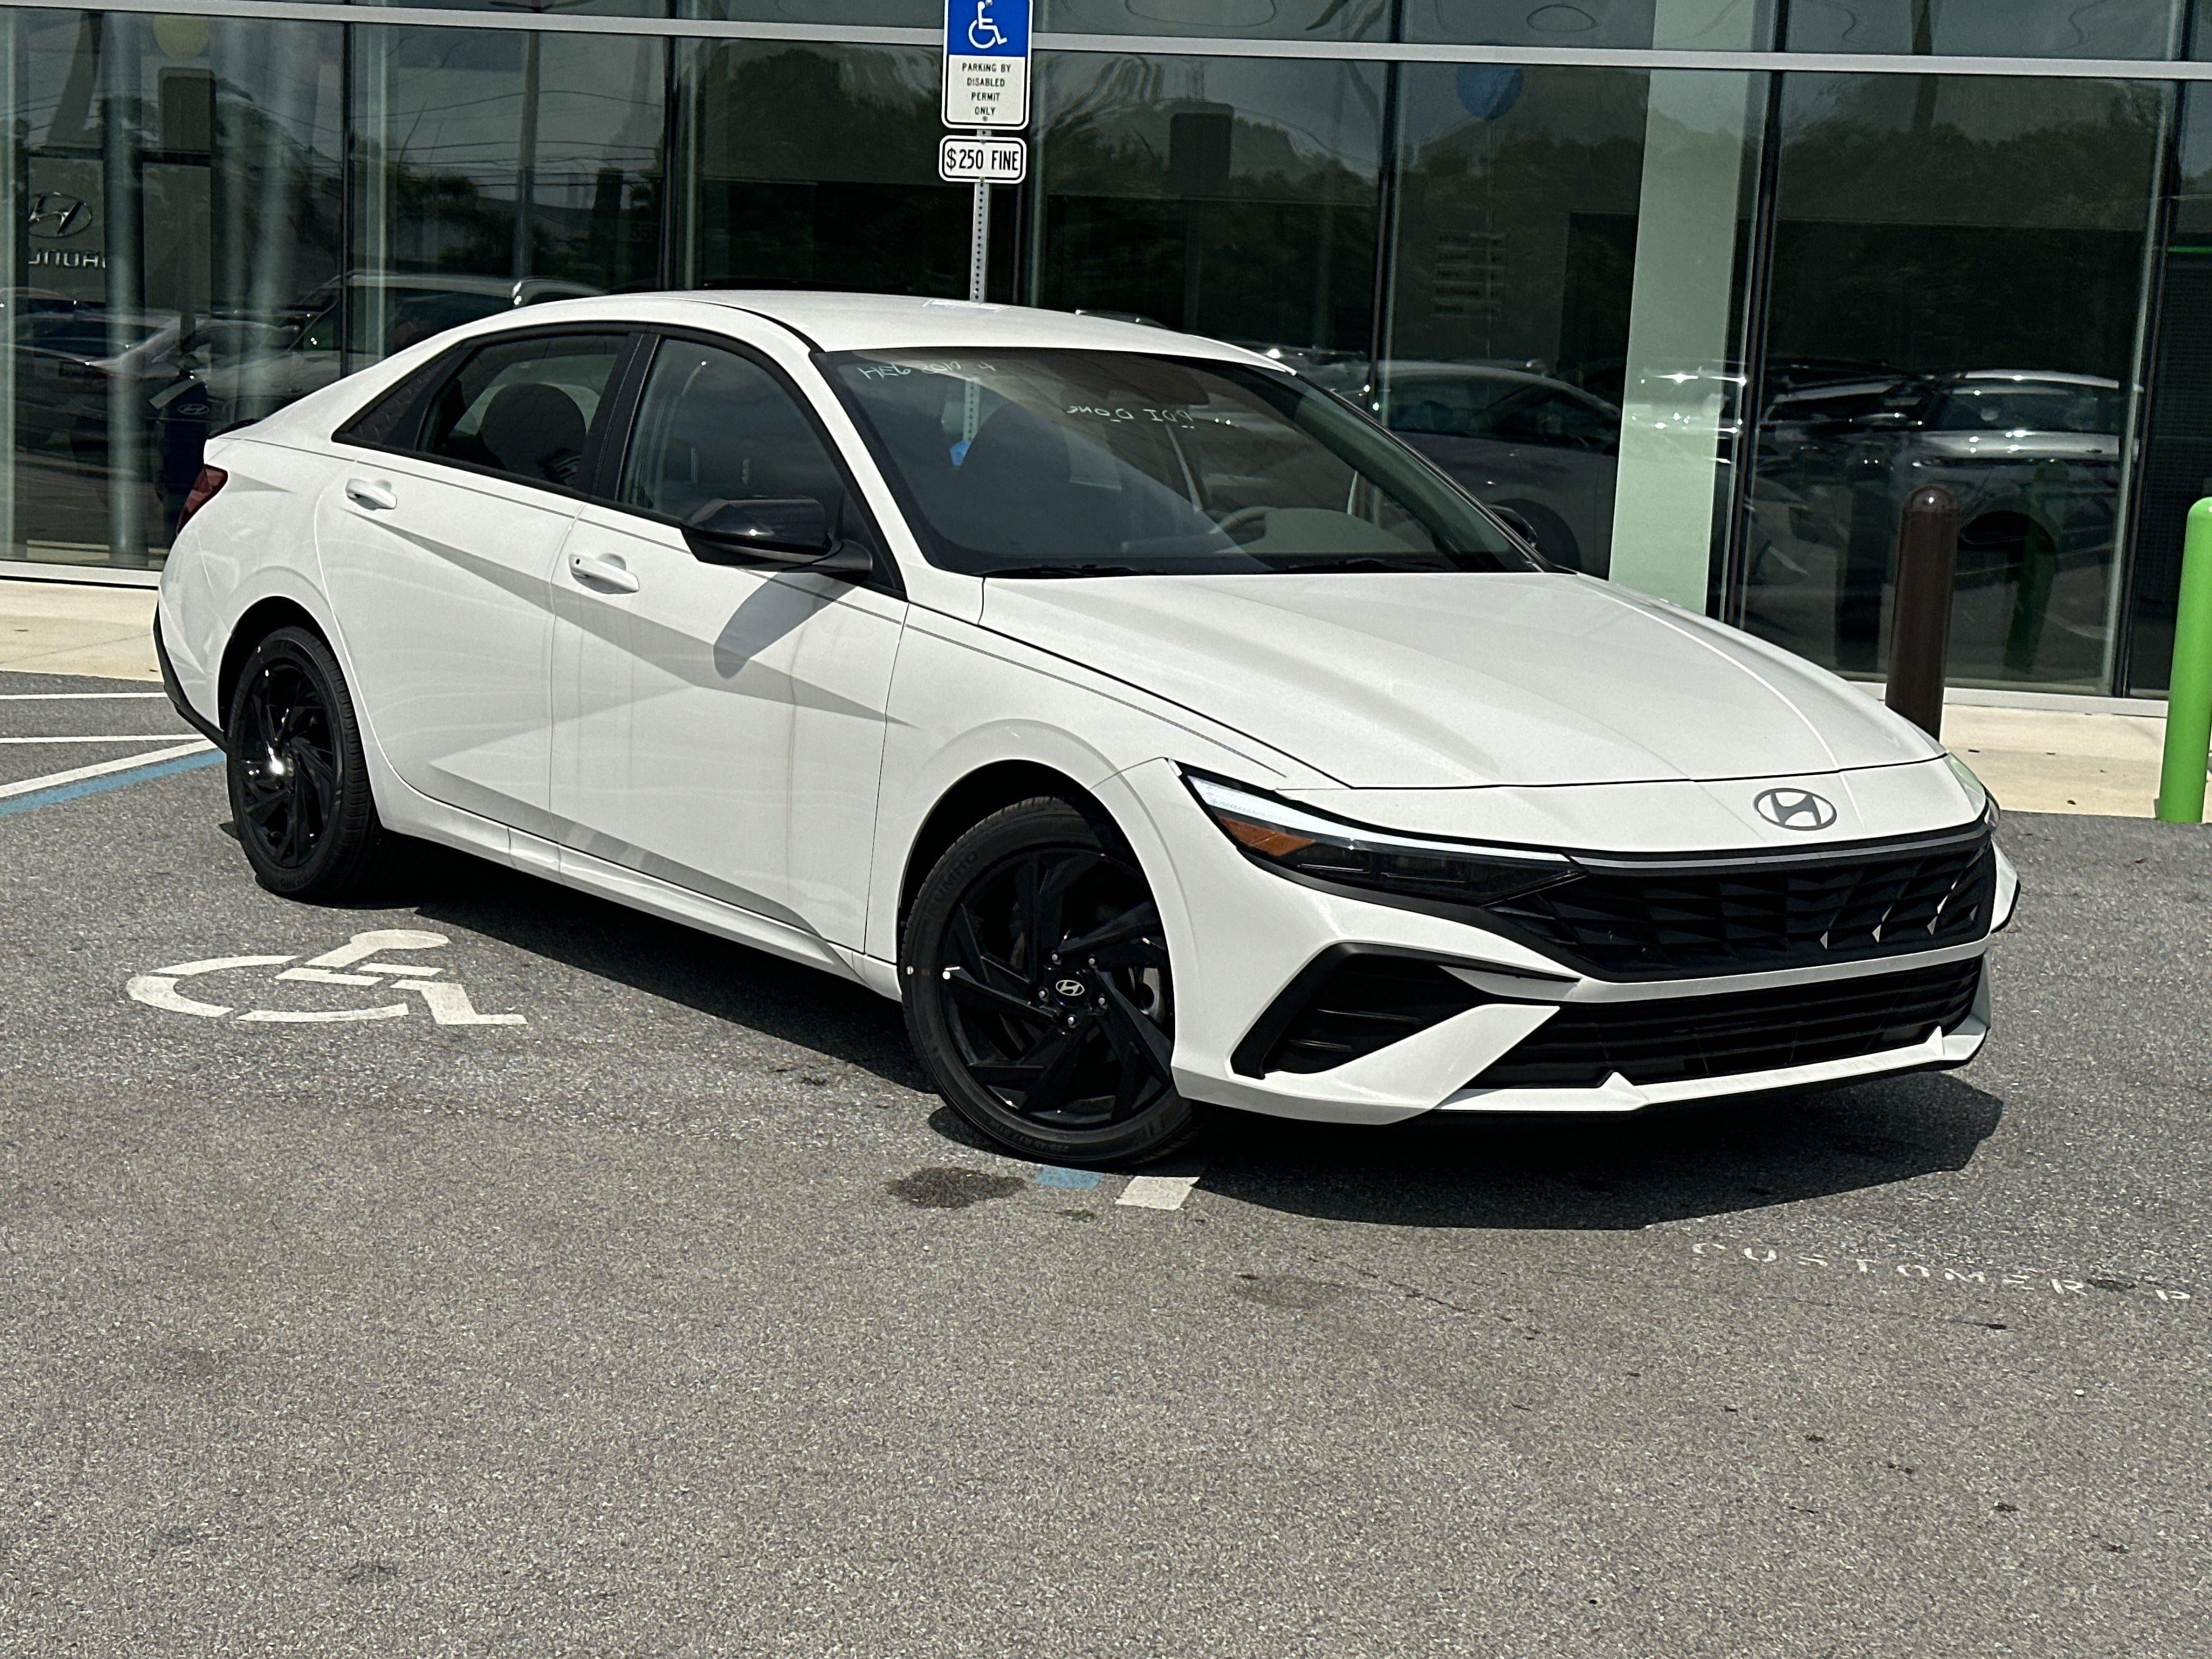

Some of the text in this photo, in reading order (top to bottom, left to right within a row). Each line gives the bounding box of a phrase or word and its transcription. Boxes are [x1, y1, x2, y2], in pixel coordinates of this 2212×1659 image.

[962, 63, 1011, 72] PARKING BY
[967, 78, 1005, 87] DISABLED
[972, 92, 1000, 101] PERMIT
[975, 107, 996, 115] ONLY
[946, 147, 1019, 171] $250 FINE
